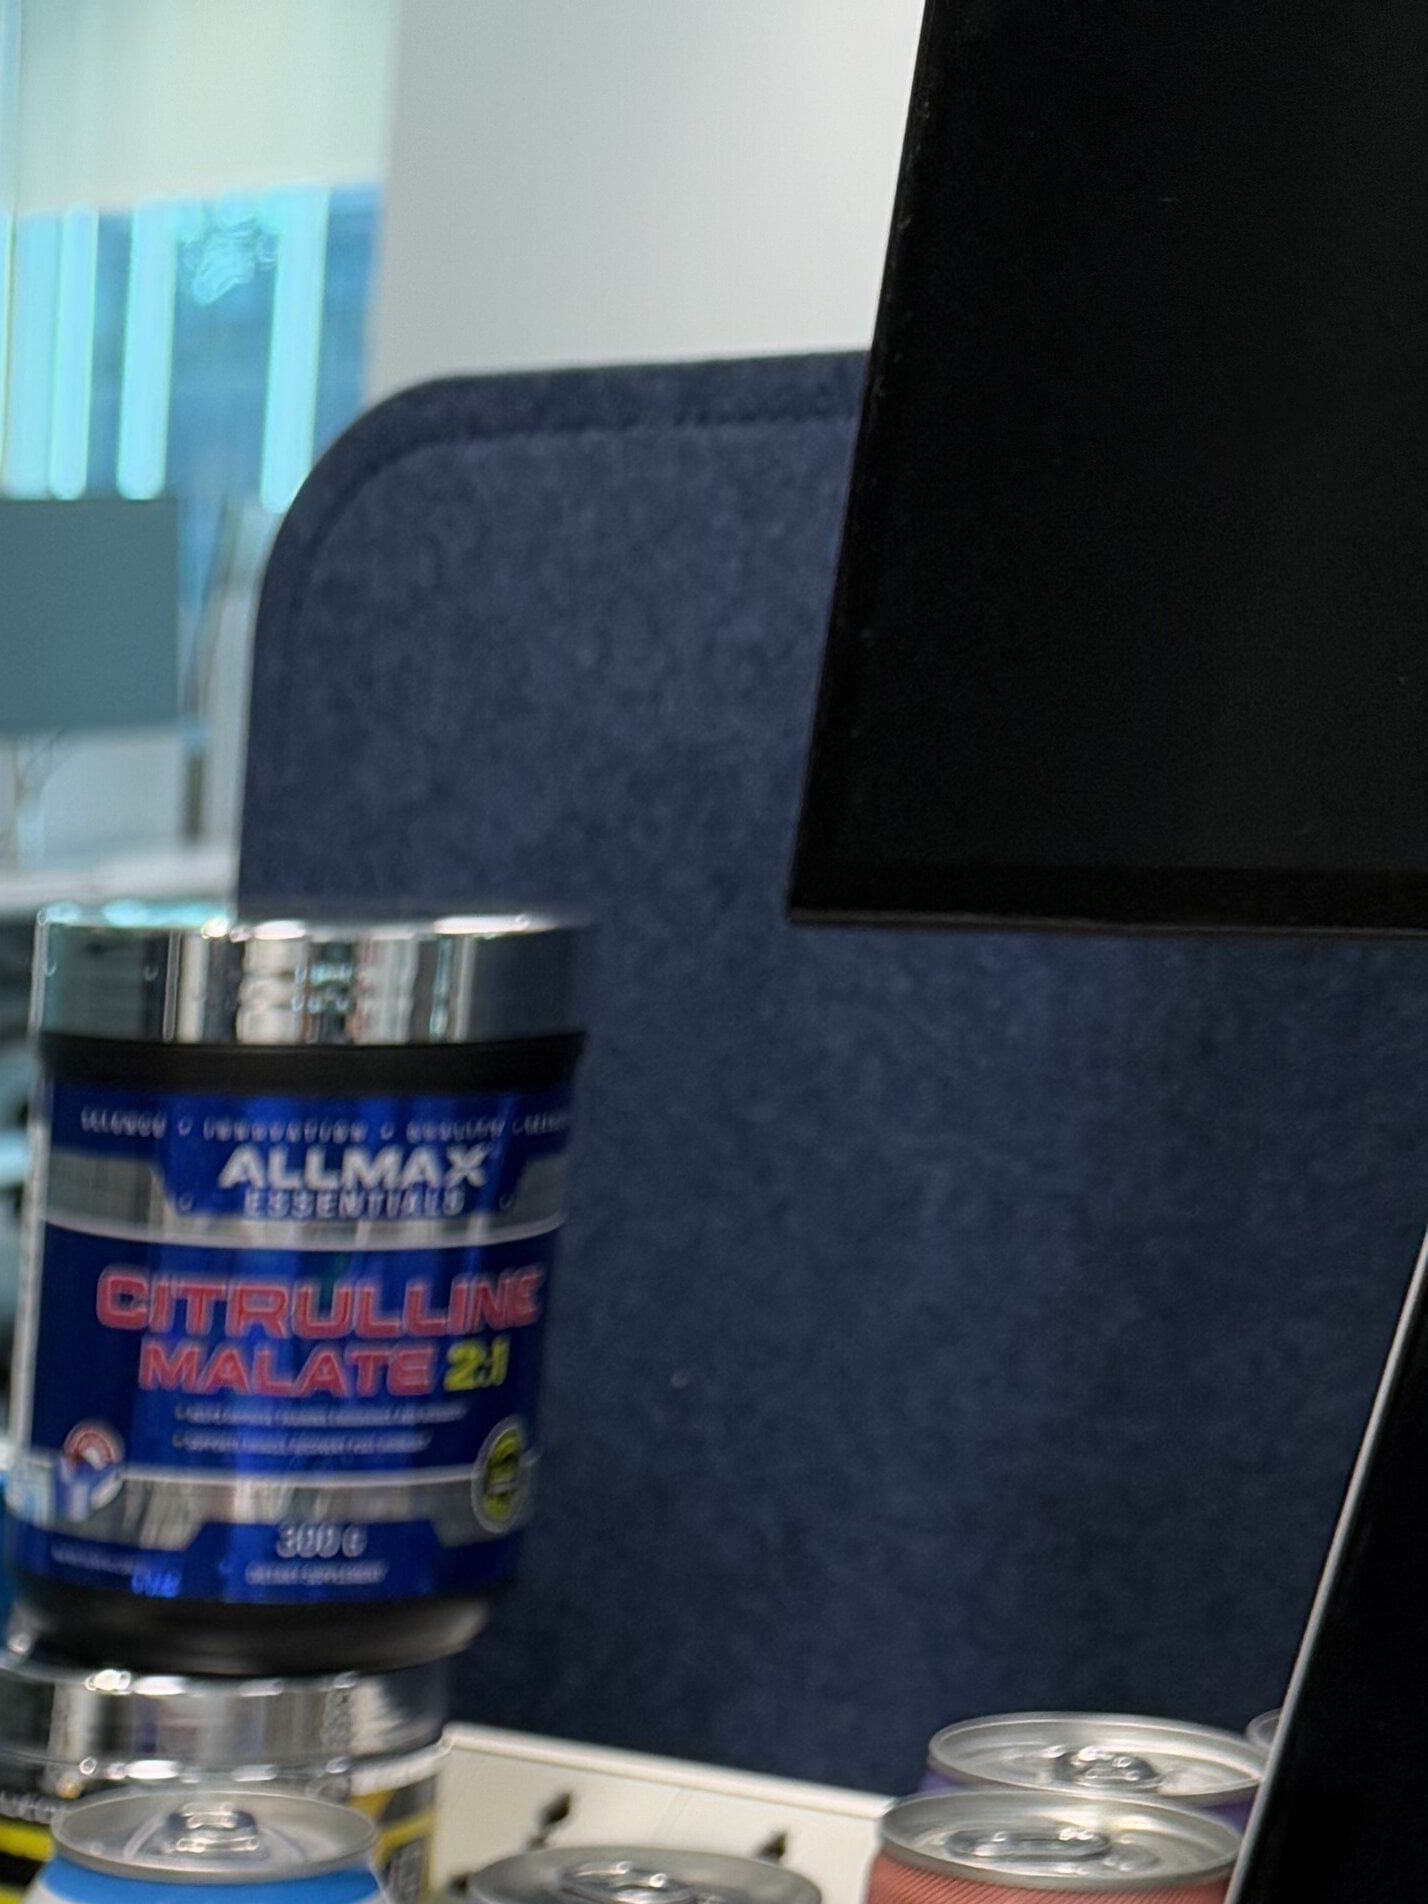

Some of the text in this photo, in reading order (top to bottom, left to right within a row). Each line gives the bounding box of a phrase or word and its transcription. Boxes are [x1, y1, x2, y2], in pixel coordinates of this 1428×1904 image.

[219, 1144, 490, 1190] ALLMAX
[97, 1264, 542, 1338] CITRULLINE
[140, 1342, 436, 1396] MALATE
